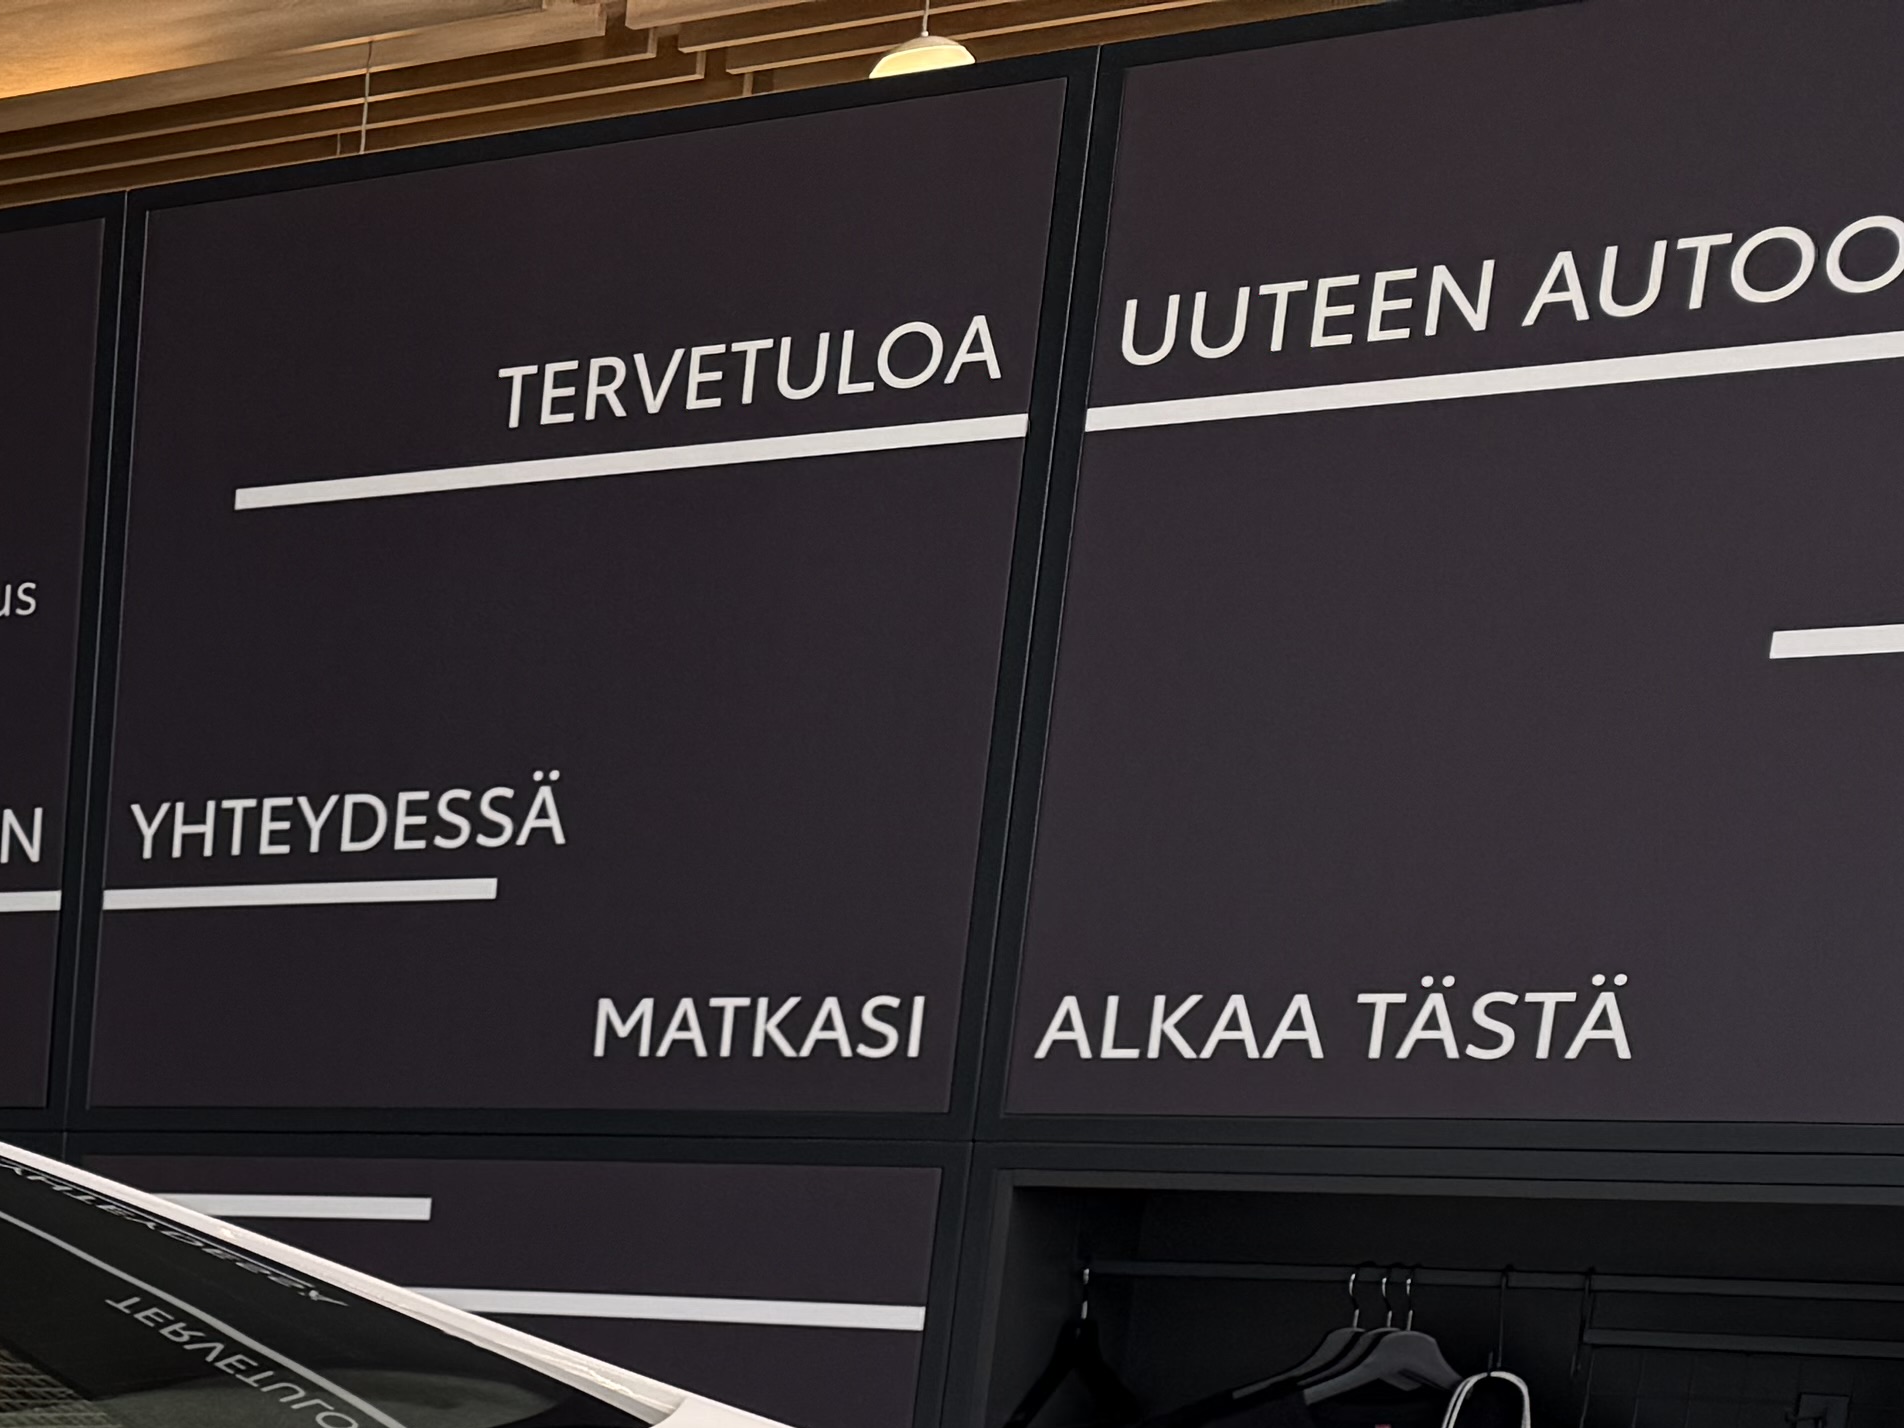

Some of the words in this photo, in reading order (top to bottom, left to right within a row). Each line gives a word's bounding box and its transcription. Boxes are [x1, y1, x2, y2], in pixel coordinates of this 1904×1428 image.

[498, 314, 1002, 428] TERVETULOA
[1120, 259, 1495, 367] UUTEEN
[1522, 214, 1904, 327] AUTOO
[130, 769, 566, 860] YHTEYDESSÄ
[592, 994, 923, 1058] MATKASI
[1036, 992, 1324, 1060] ALKAA
[1355, 973, 1632, 1061] TÄSTÄ
